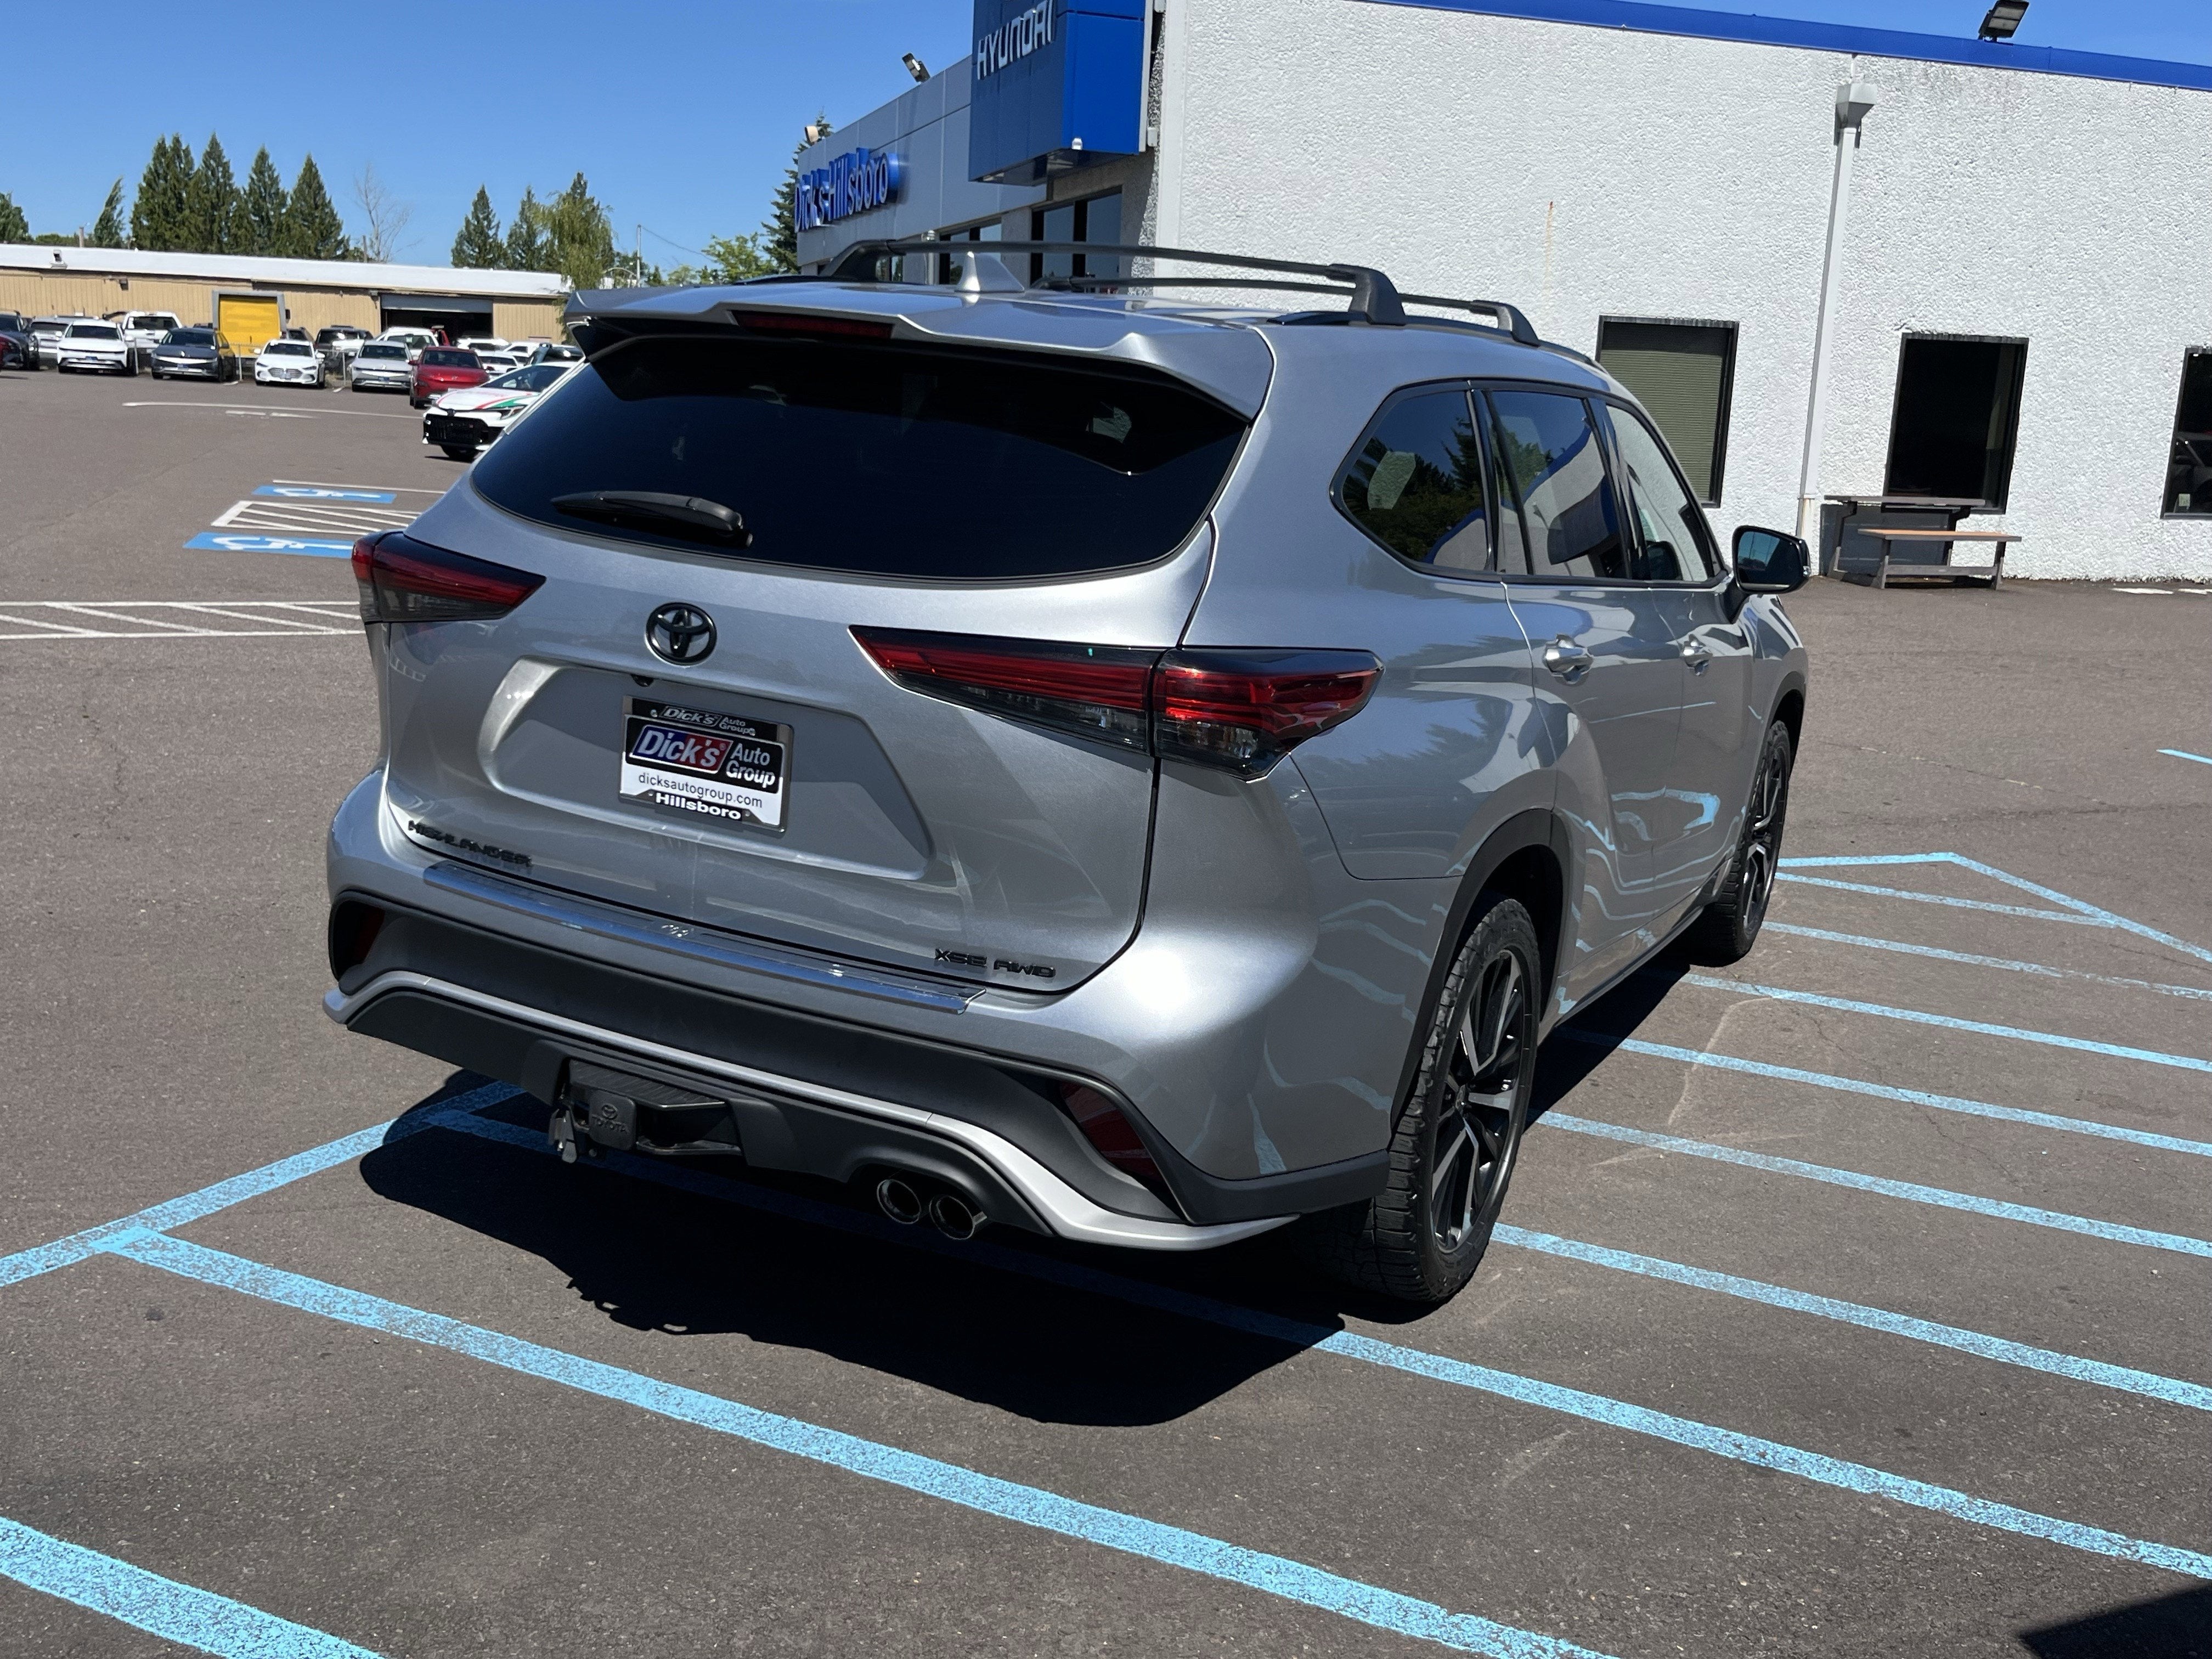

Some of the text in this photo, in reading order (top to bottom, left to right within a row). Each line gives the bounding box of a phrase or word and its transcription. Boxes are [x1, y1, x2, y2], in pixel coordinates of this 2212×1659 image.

[978, 0, 1052, 80] HYUNDAI
[828, 148, 894, 221] Hillsboro
[663, 707, 715, 725] Dick's
[719, 722, 751, 735] Group
[722, 716, 746, 727] Auto
[637, 730, 721, 768] Dick's
[731, 743, 770, 766] Auto
[726, 760, 776, 788] Group
[639, 772, 763, 808] dicksautogroup.com
[656, 792, 742, 820] Hillsboro
[934, 948, 1056, 978] XSE AWD
